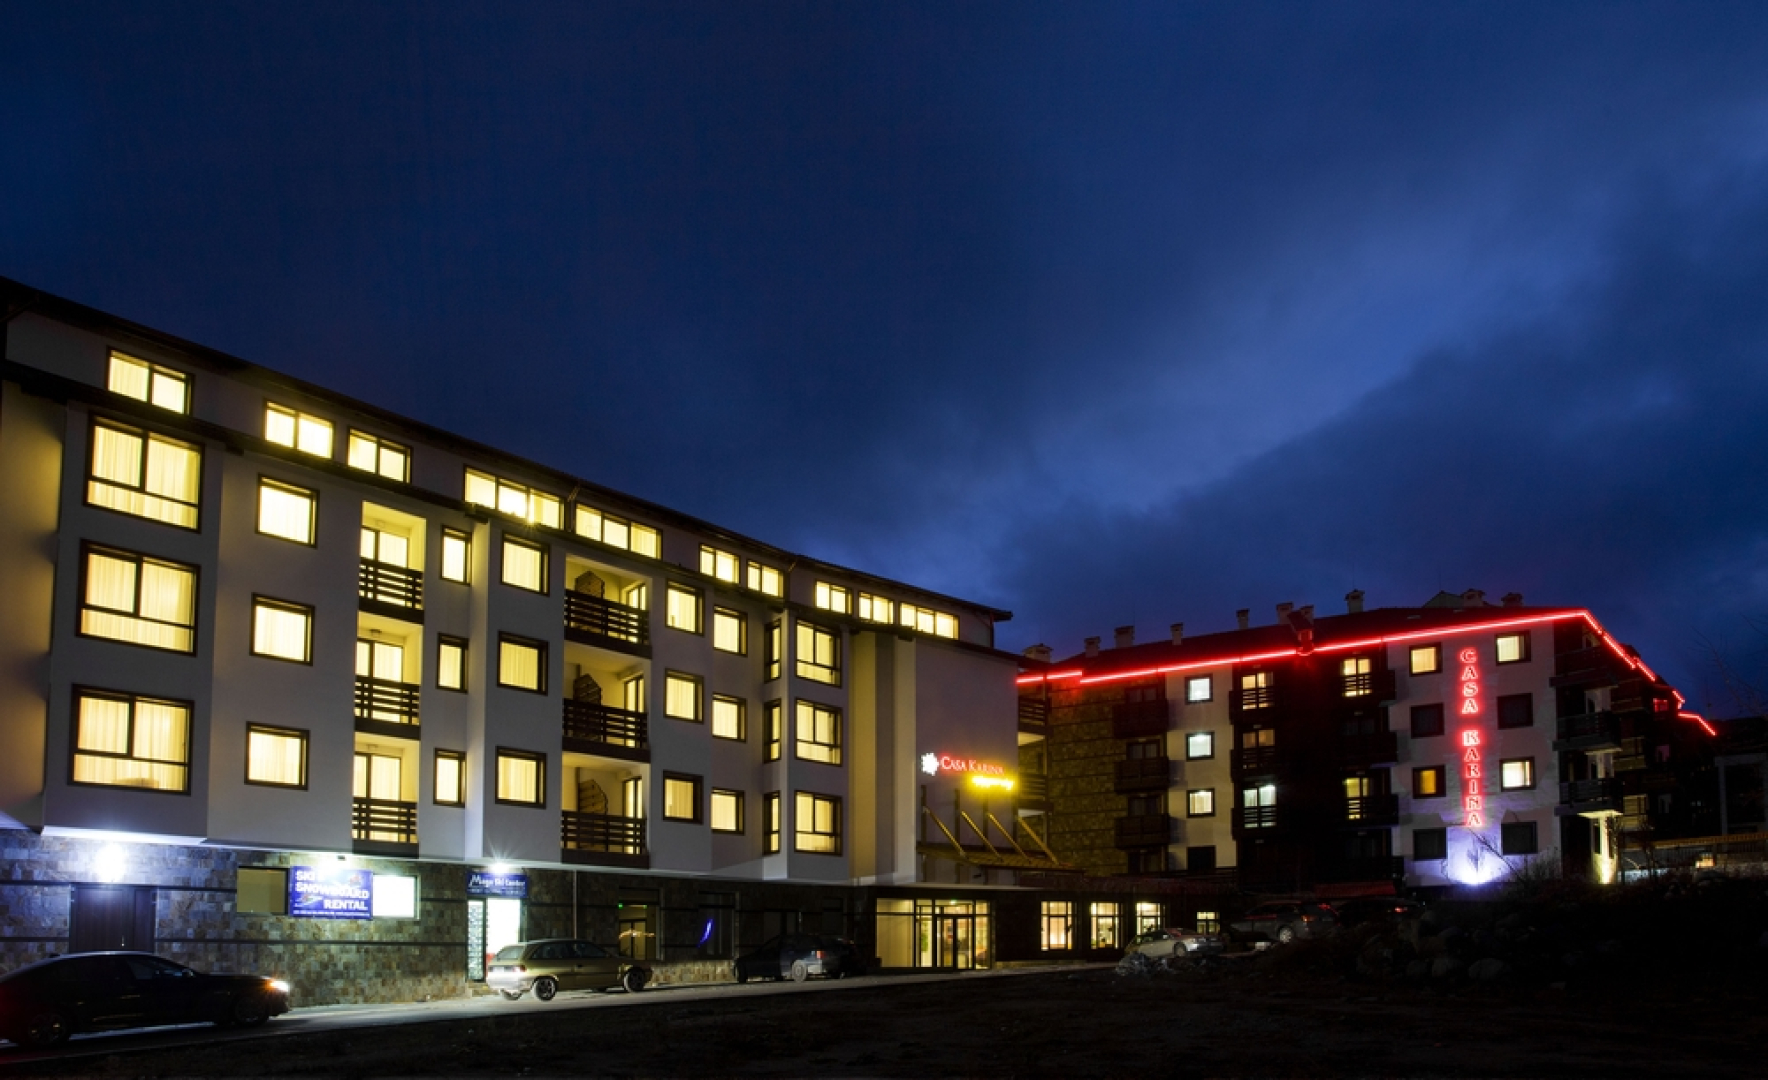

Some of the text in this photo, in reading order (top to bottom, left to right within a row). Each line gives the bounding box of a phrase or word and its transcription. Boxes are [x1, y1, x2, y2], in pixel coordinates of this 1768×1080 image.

[1460, 647, 1482, 828] CASA KARINA
[323, 899, 369, 911] RENTAL
